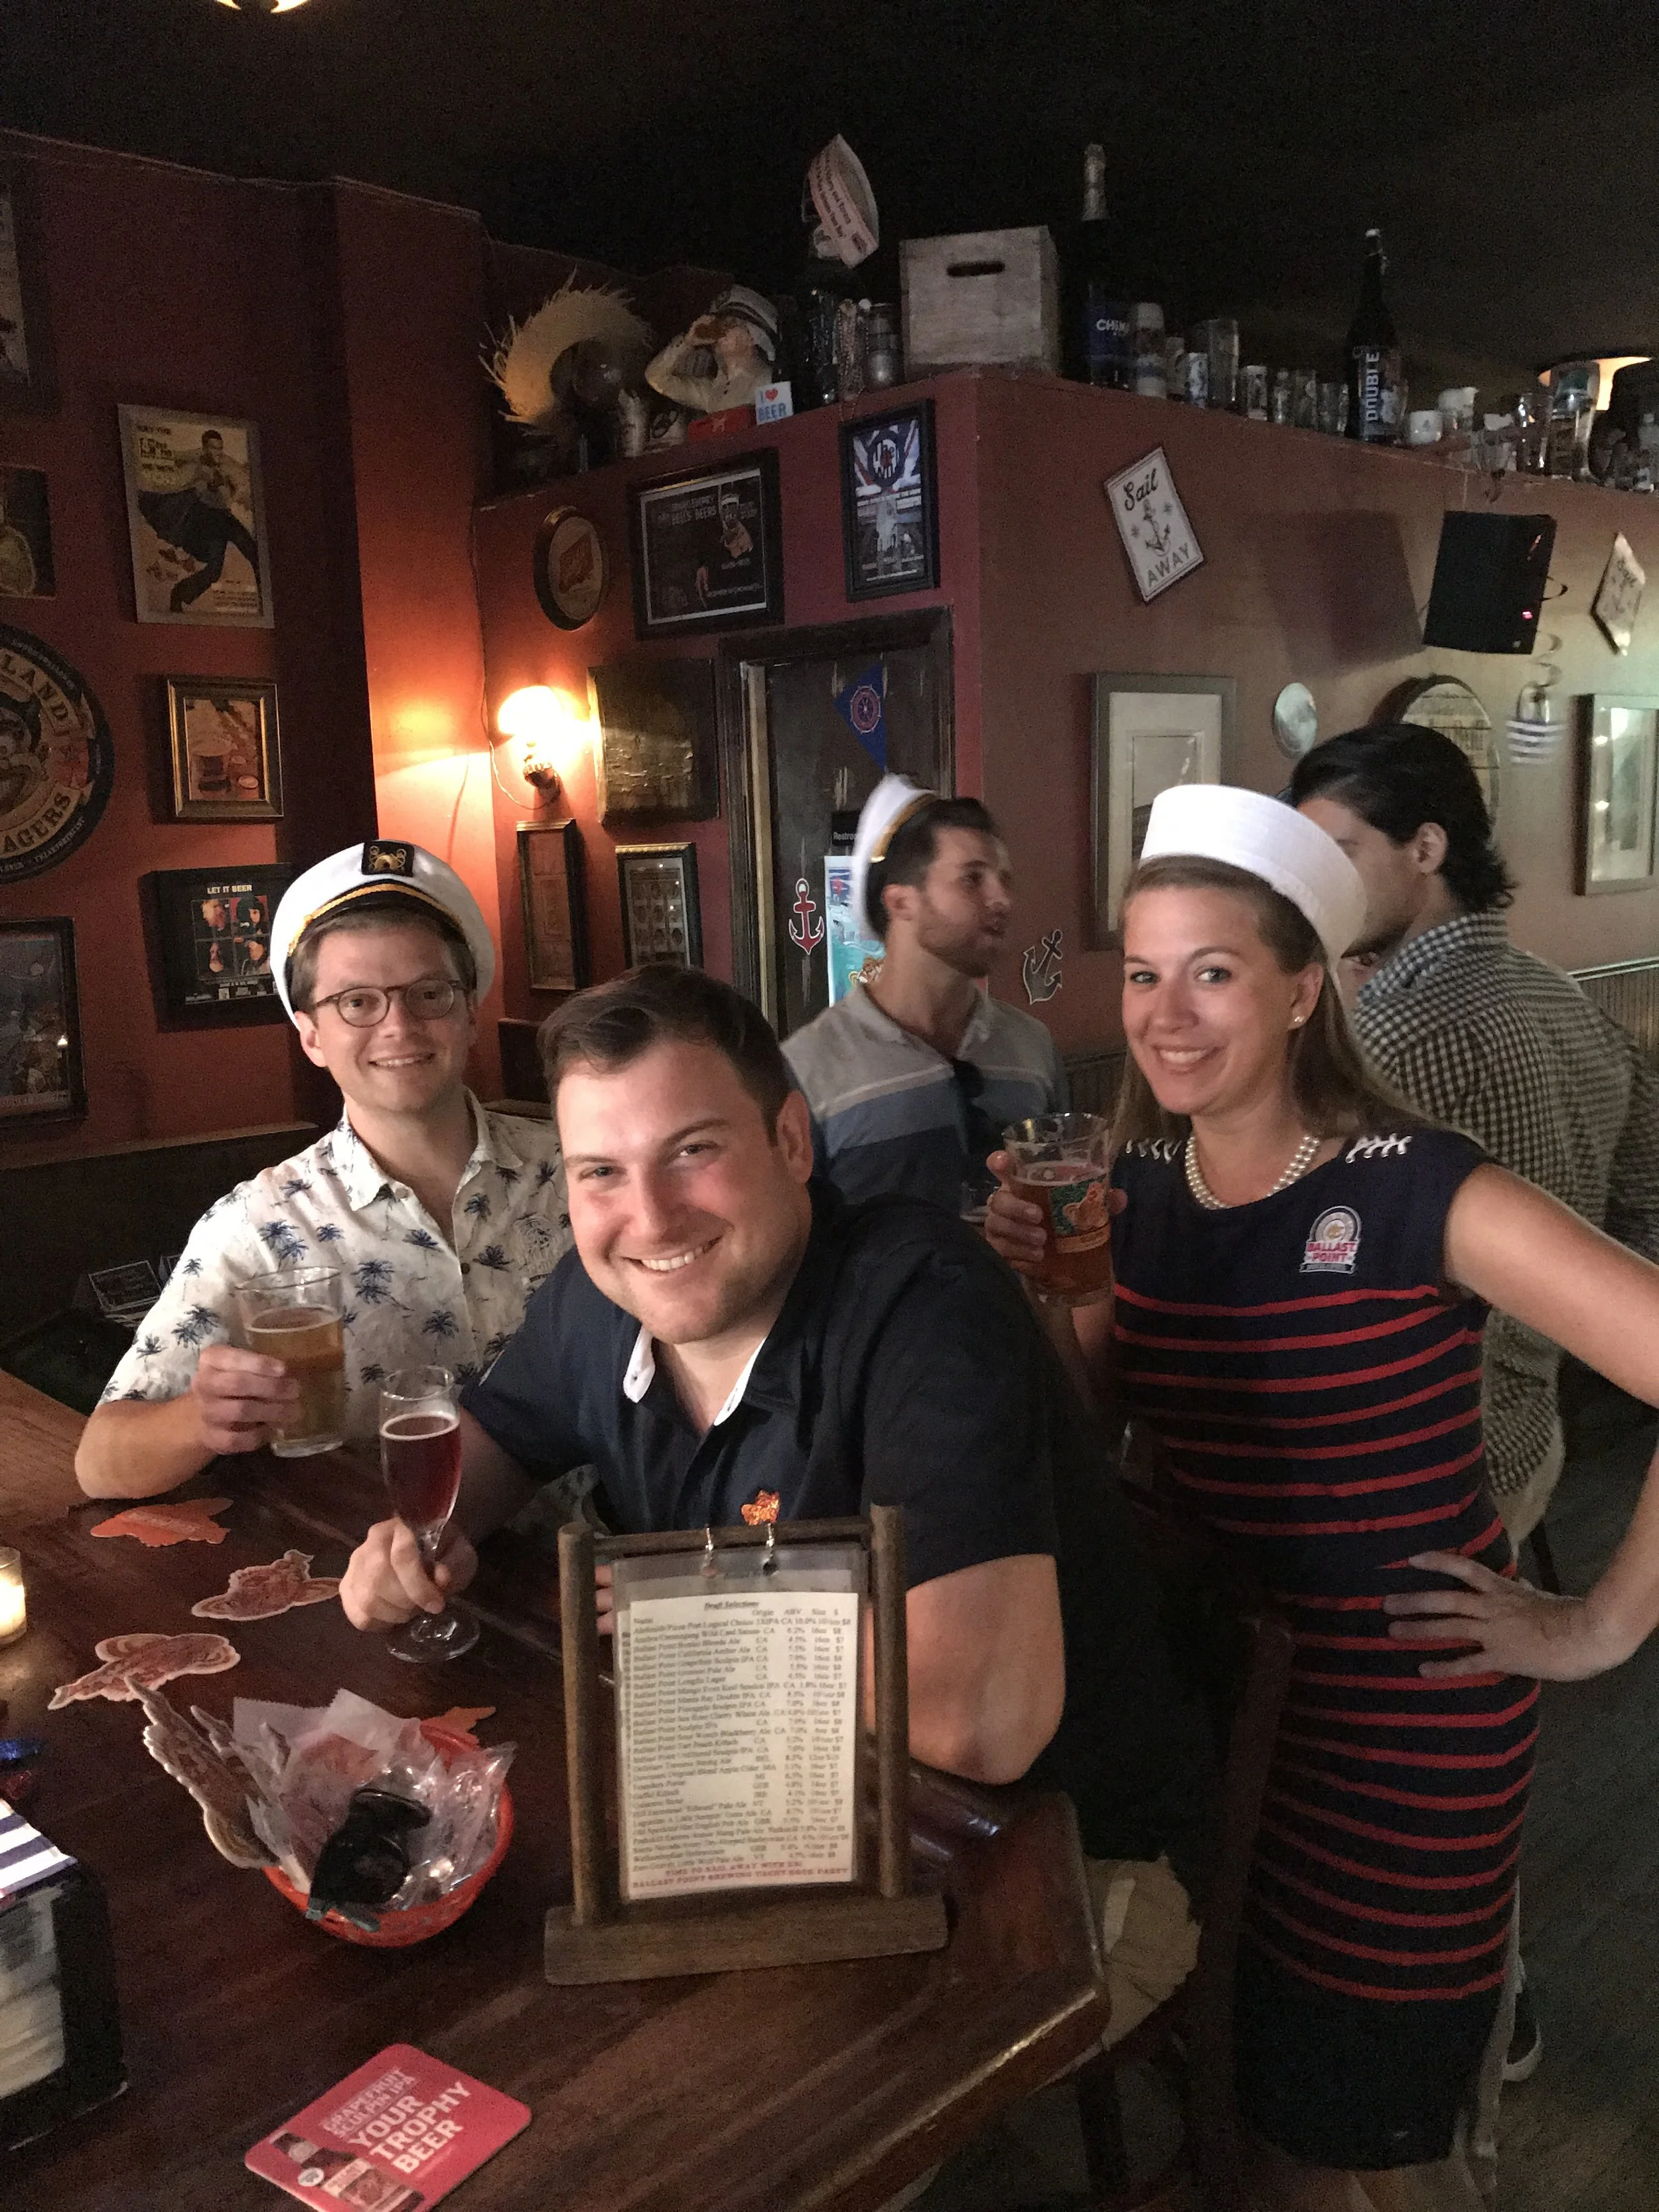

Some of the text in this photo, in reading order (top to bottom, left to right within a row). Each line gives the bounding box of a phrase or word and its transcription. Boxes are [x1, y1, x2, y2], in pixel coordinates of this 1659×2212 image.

[758, 403, 787, 421] BEER
[1123, 467, 1159, 511] Sail
[1147, 542, 1190, 587] AWAY
[2, 790, 71, 854] AGERS
[1307, 1242, 1355, 1252] BALLAST
[1312, 1252, 1348, 1262] POINT
[347, 2095, 425, 2148] YOUR
[369, 2081, 472, 2160] TROPHY
[392, 2120, 464, 2173] BEER
